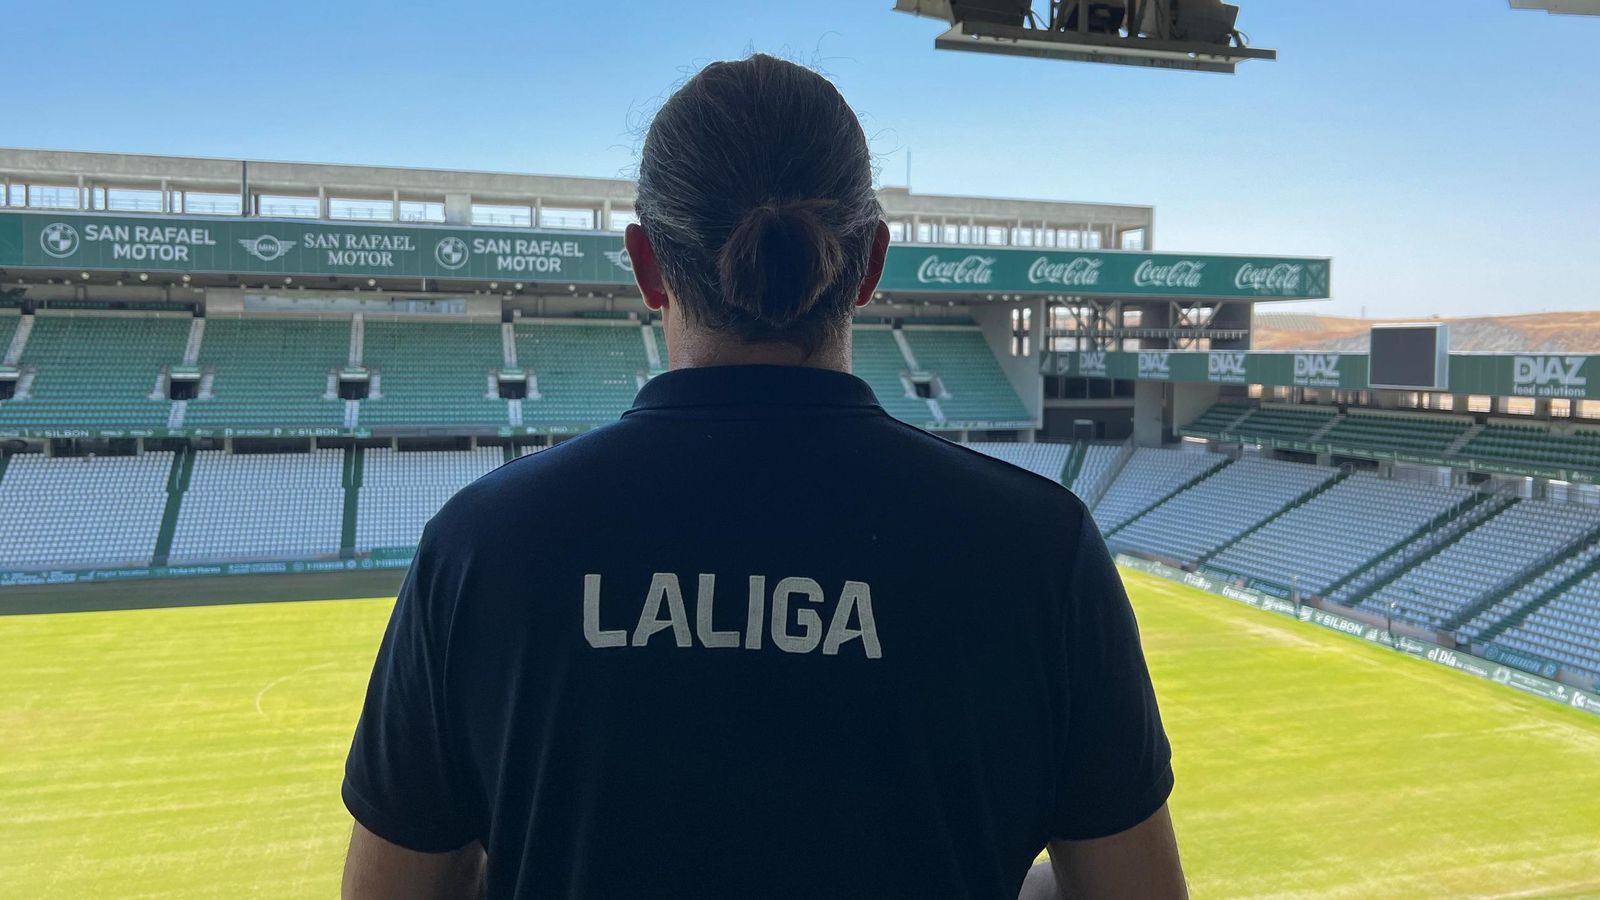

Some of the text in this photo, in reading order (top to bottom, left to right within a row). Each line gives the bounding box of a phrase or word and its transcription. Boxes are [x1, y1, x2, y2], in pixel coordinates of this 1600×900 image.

[85, 224, 129, 241] SAN
[135, 226, 216, 246] RAFAEL
[304, 233, 415, 251] SAN RAFAEL
[113, 243, 189, 262] MOTOR
[473, 238, 511, 255] SAN
[516, 239, 584, 257] RAFAEL
[328, 250, 394, 267] MOTOR
[497, 255, 561, 272] MOTOR
[1138, 353, 1169, 372] DIAZ
[1208, 353, 1246, 375] DIAZ
[1294, 354, 1340, 379] DIAZ
[1513, 356, 1587, 385] DIAZ
[1513, 384, 1587, 397] food solutions
[298, 428, 338, 436] SILBON
[583, 572, 882, 659] LALIGA
[1323, 615, 1363, 636] SILBON
[1427, 648, 1439, 661] el
[1439, 648, 1457, 667] Día
